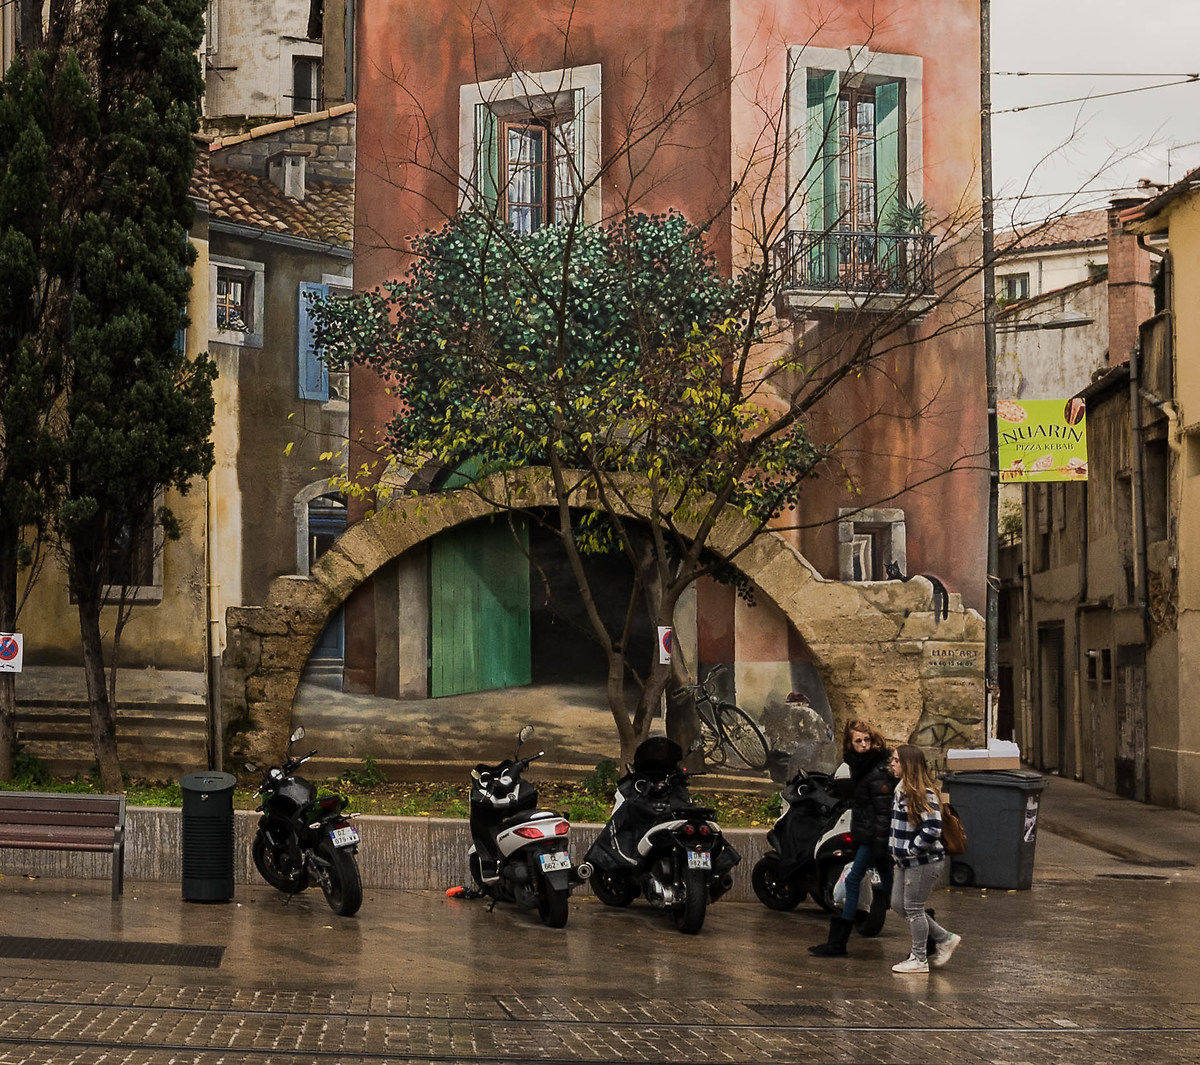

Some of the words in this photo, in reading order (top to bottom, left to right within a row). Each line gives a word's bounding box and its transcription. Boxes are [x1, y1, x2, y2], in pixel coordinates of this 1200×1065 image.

[1002, 424, 1084, 445] NUARIN
[1016, 443, 1042, 451] PIZZA
[1044, 443, 1074, 451] KEBAB
